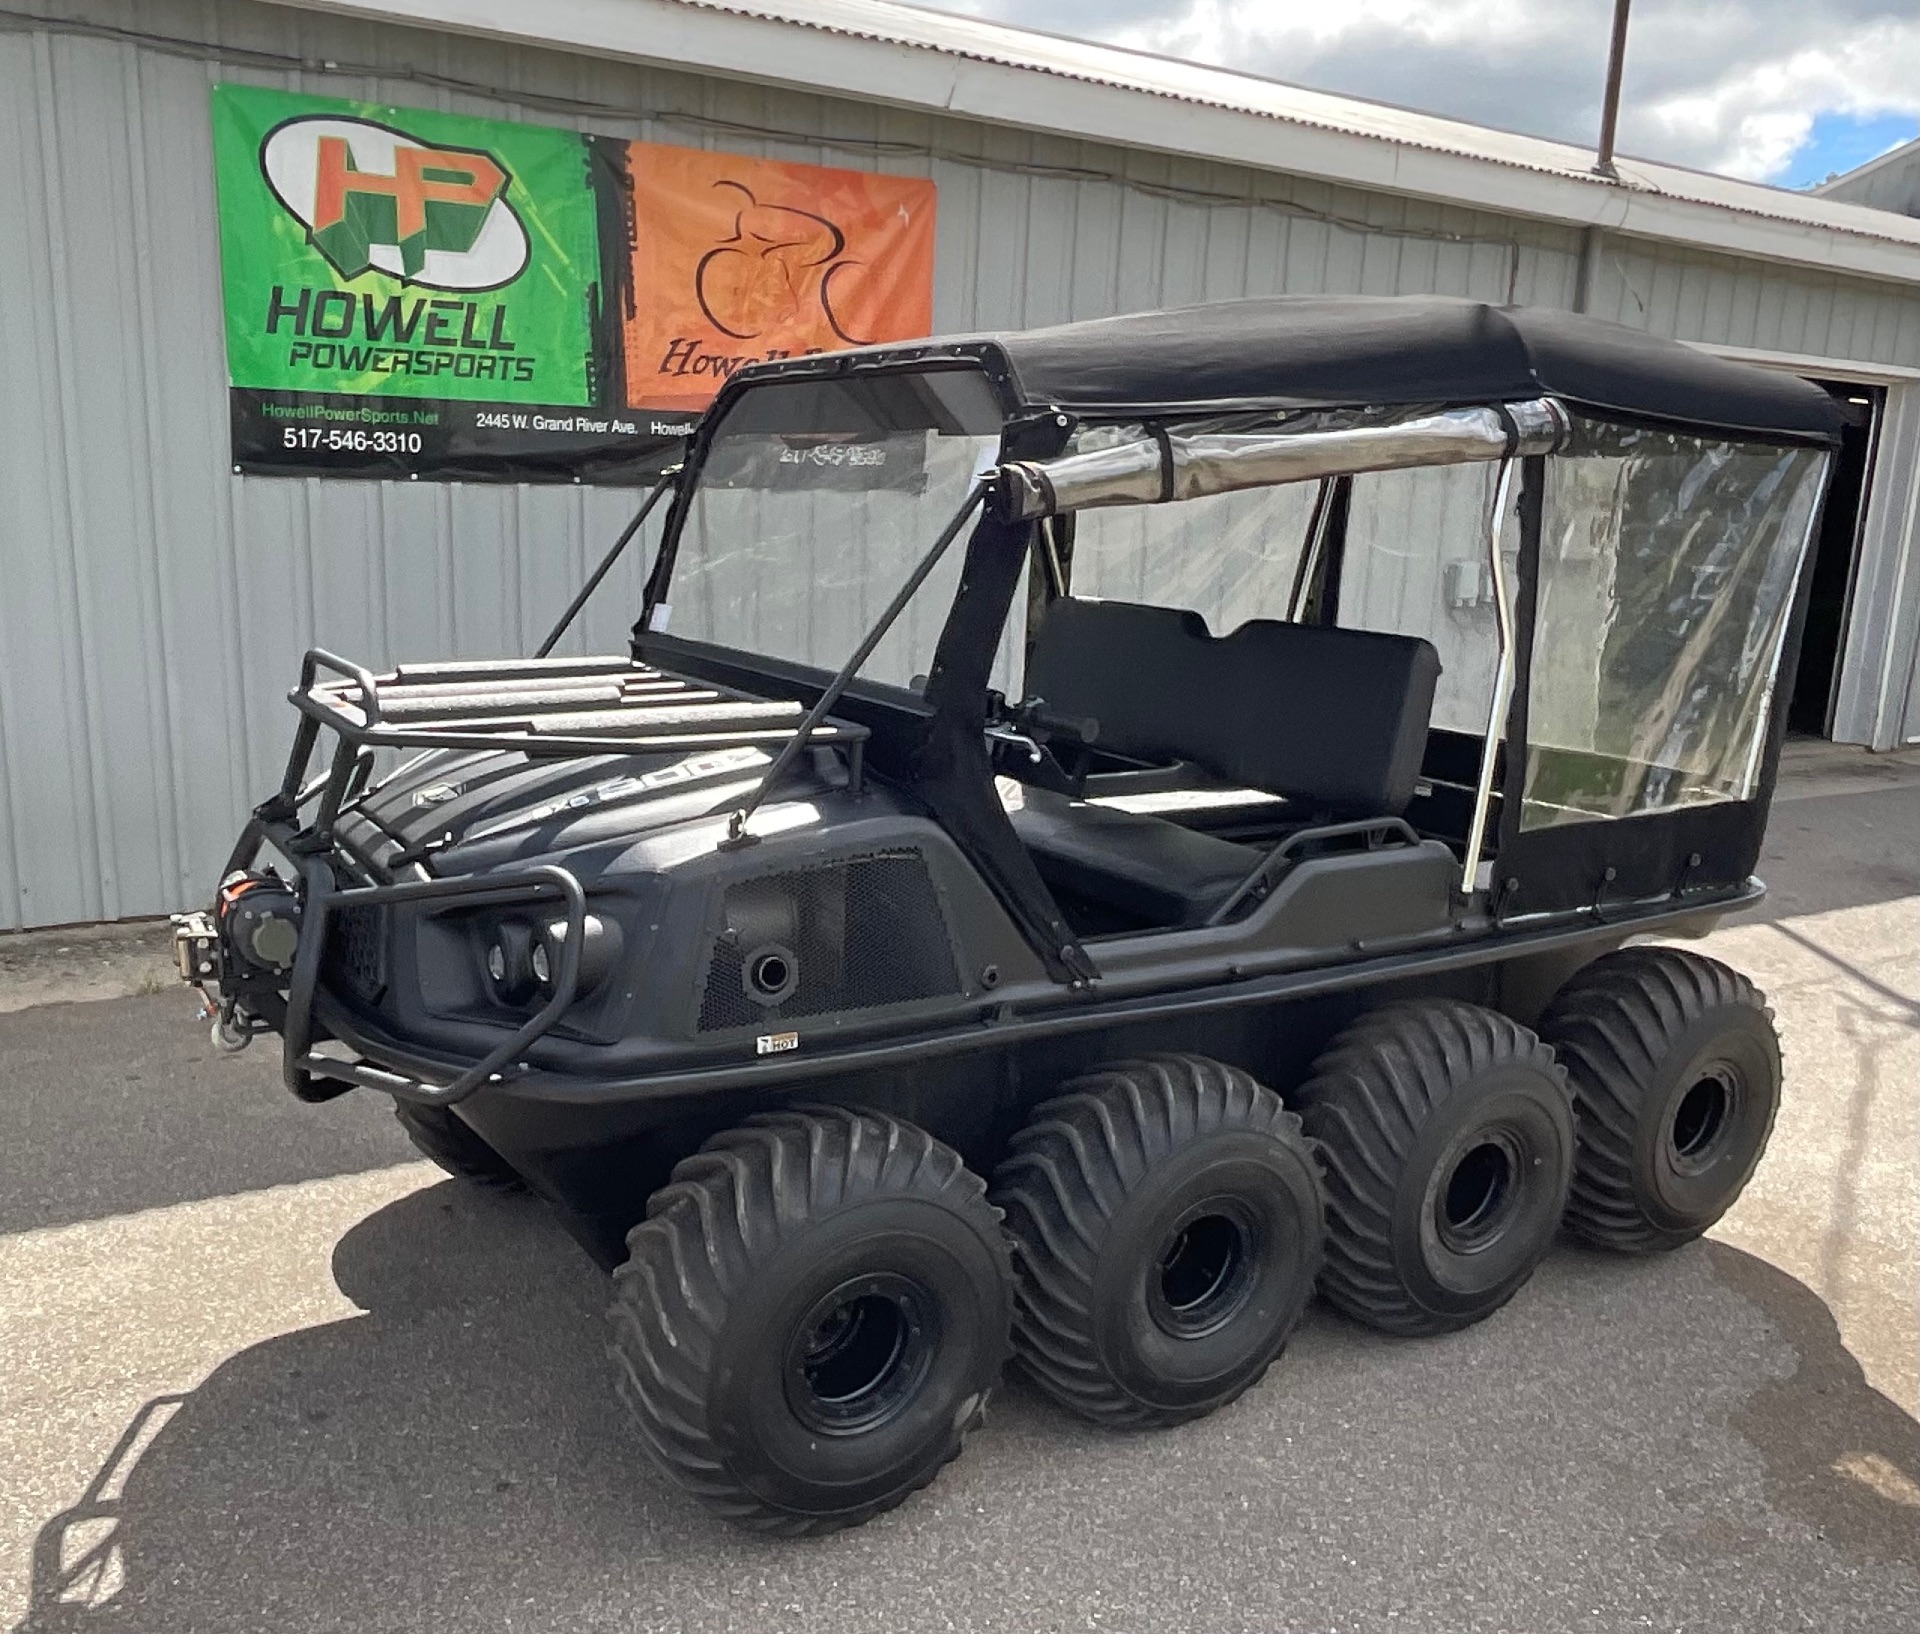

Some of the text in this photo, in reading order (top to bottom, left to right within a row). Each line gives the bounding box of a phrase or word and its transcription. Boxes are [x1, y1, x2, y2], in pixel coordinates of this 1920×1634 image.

[312, 135, 506, 270] HP
[266, 286, 516, 351] HOWELL
[289, 342, 536, 382] POWERSPORTS
[261, 403, 439, 426] HowellPowerSports.Net
[476, 413, 509, 429] 2445
[513, 414, 529, 430] W.
[533, 415, 573, 432] Grand
[576, 417, 608, 433] River
[612, 419, 638, 435] Ave.
[283, 427, 422, 453] 517-546-3310
[772, 1039, 796, 1050] HOT
